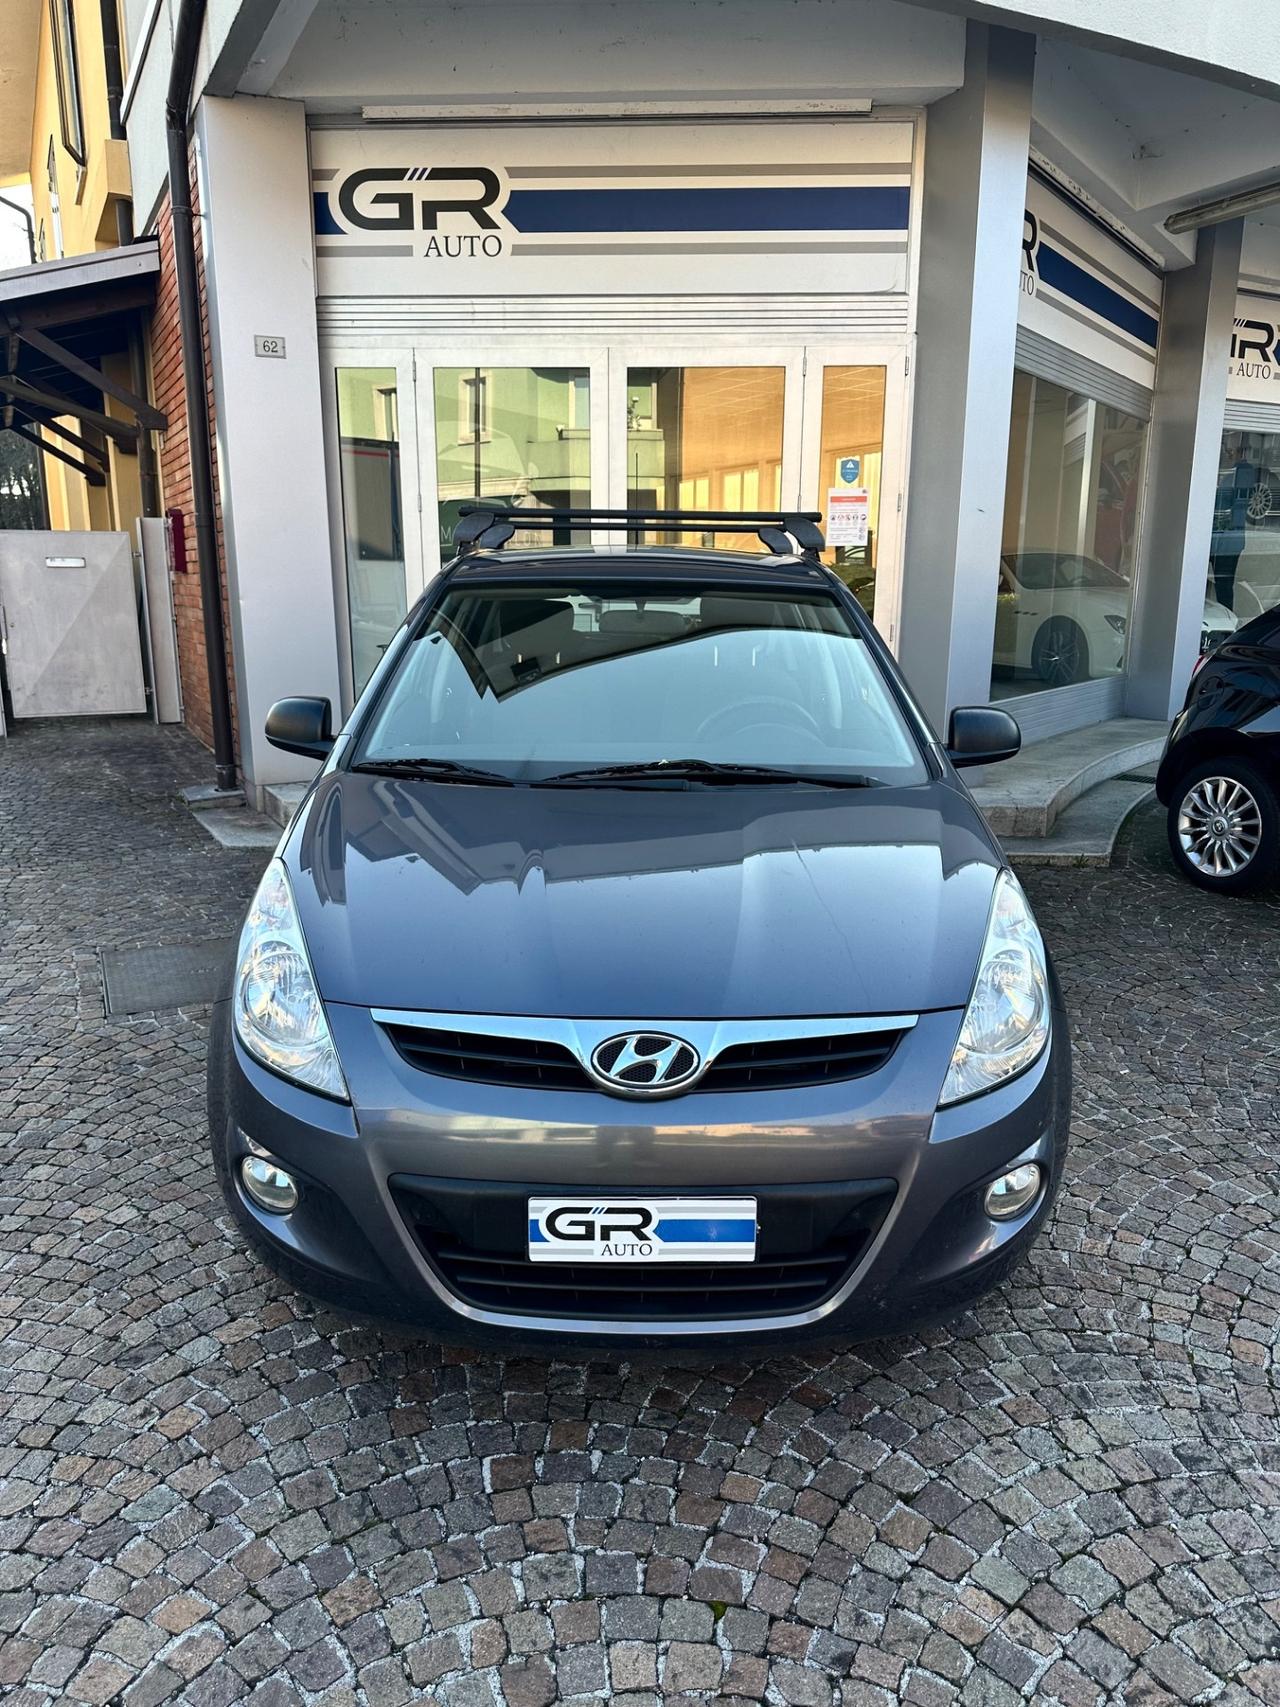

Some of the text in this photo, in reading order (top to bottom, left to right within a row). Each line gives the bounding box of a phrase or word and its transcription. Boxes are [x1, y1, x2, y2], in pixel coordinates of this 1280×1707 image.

[338, 166, 502, 230] GR
[423, 234, 503, 257] AUTO
[1019, 270, 1034, 295] TO
[263, 340, 278, 352] 62
[1230, 317, 1274, 363] R
[1236, 362, 1271, 379] AUTO
[545, 1206, 653, 1241] GR
[601, 1243, 653, 1256] AUTO
